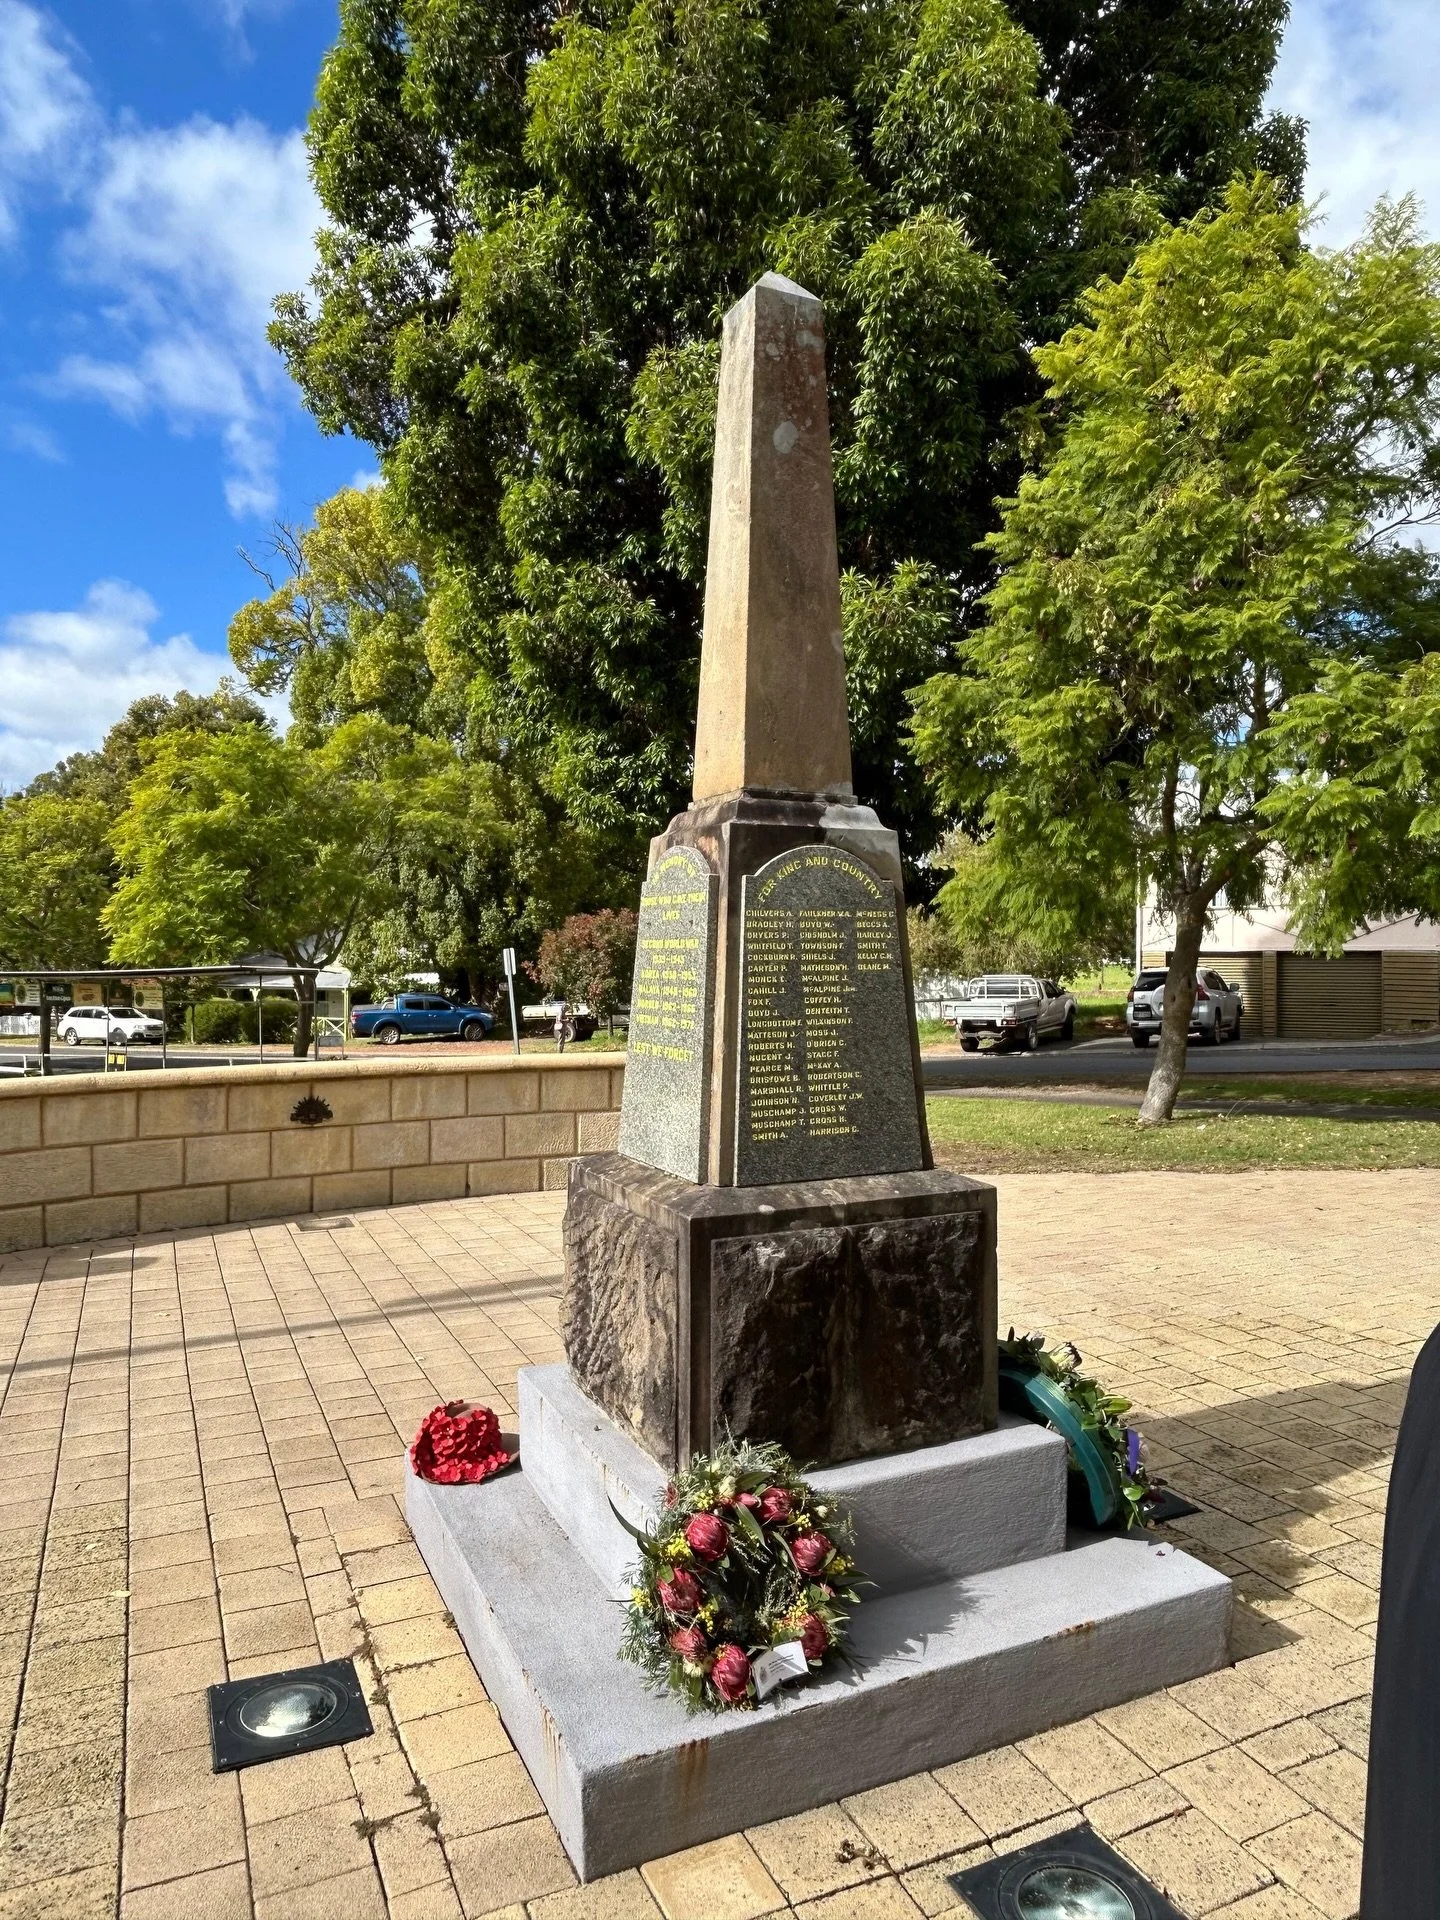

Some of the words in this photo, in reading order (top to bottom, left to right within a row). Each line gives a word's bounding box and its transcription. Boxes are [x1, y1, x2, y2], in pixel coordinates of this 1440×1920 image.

[757, 878, 777, 903] FOR
[776, 860, 802, 880] KING
[805, 856, 829, 867] AND
[833, 858, 883, 901] COUNTRY
[745, 909, 786, 917] CHILVERS
[799, 910, 836, 918] FAULKNER
[746, 920, 784, 928] BRADLEY
[857, 942, 881, 950] SMITH
[857, 952, 879, 960] KELLY
[747, 964, 779, 973] CARTER
[747, 986, 777, 995] CAHILL
[747, 998, 764, 1006] FOX
[748, 1009, 770, 1017] BOYD
[805, 1018, 847, 1026] WILKINSON
[805, 1029, 829, 1037] MOSS
[748, 1042, 785, 1051] ROBERTS
[633, 1040, 651, 1055] LEST
[651, 1043, 663, 1057] WE
[663, 1045, 694, 1063] FORGET
[750, 1064, 782, 1073] PEARCE
[807, 1071, 854, 1081] ROBERTSON
[750, 1086, 794, 1096] MARSHALL
[808, 1083, 841, 1092] WHITTLE
[751, 1097, 790, 1107] JOHNSON
[808, 1094, 847, 1103] COVERLEY
[751, 1108, 797, 1118] MUSCHAMP
[751, 1119, 797, 1129] MUSCHAMP
[809, 1126, 850, 1136] HARRISON
[752, 1131, 778, 1141] SMITH
